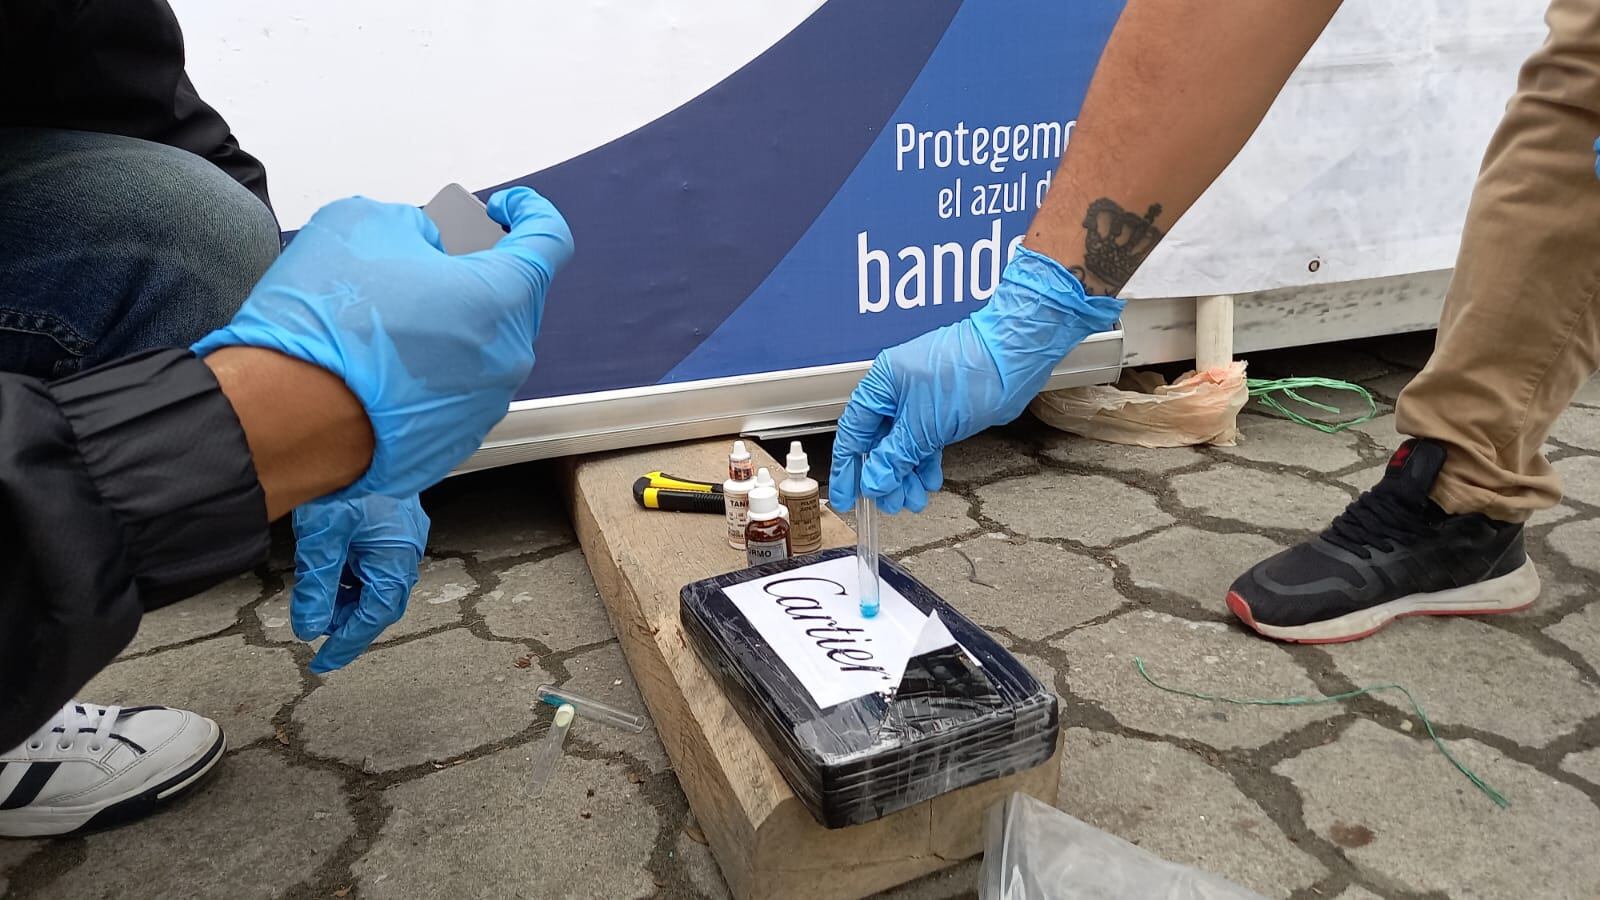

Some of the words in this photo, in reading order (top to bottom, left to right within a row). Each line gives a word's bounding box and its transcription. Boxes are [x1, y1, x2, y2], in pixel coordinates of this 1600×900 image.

[938, 177, 961, 218] el
[970, 172, 1026, 215] azul
[1036, 169, 1052, 208] d
[763, 577, 891, 680] Cartier
